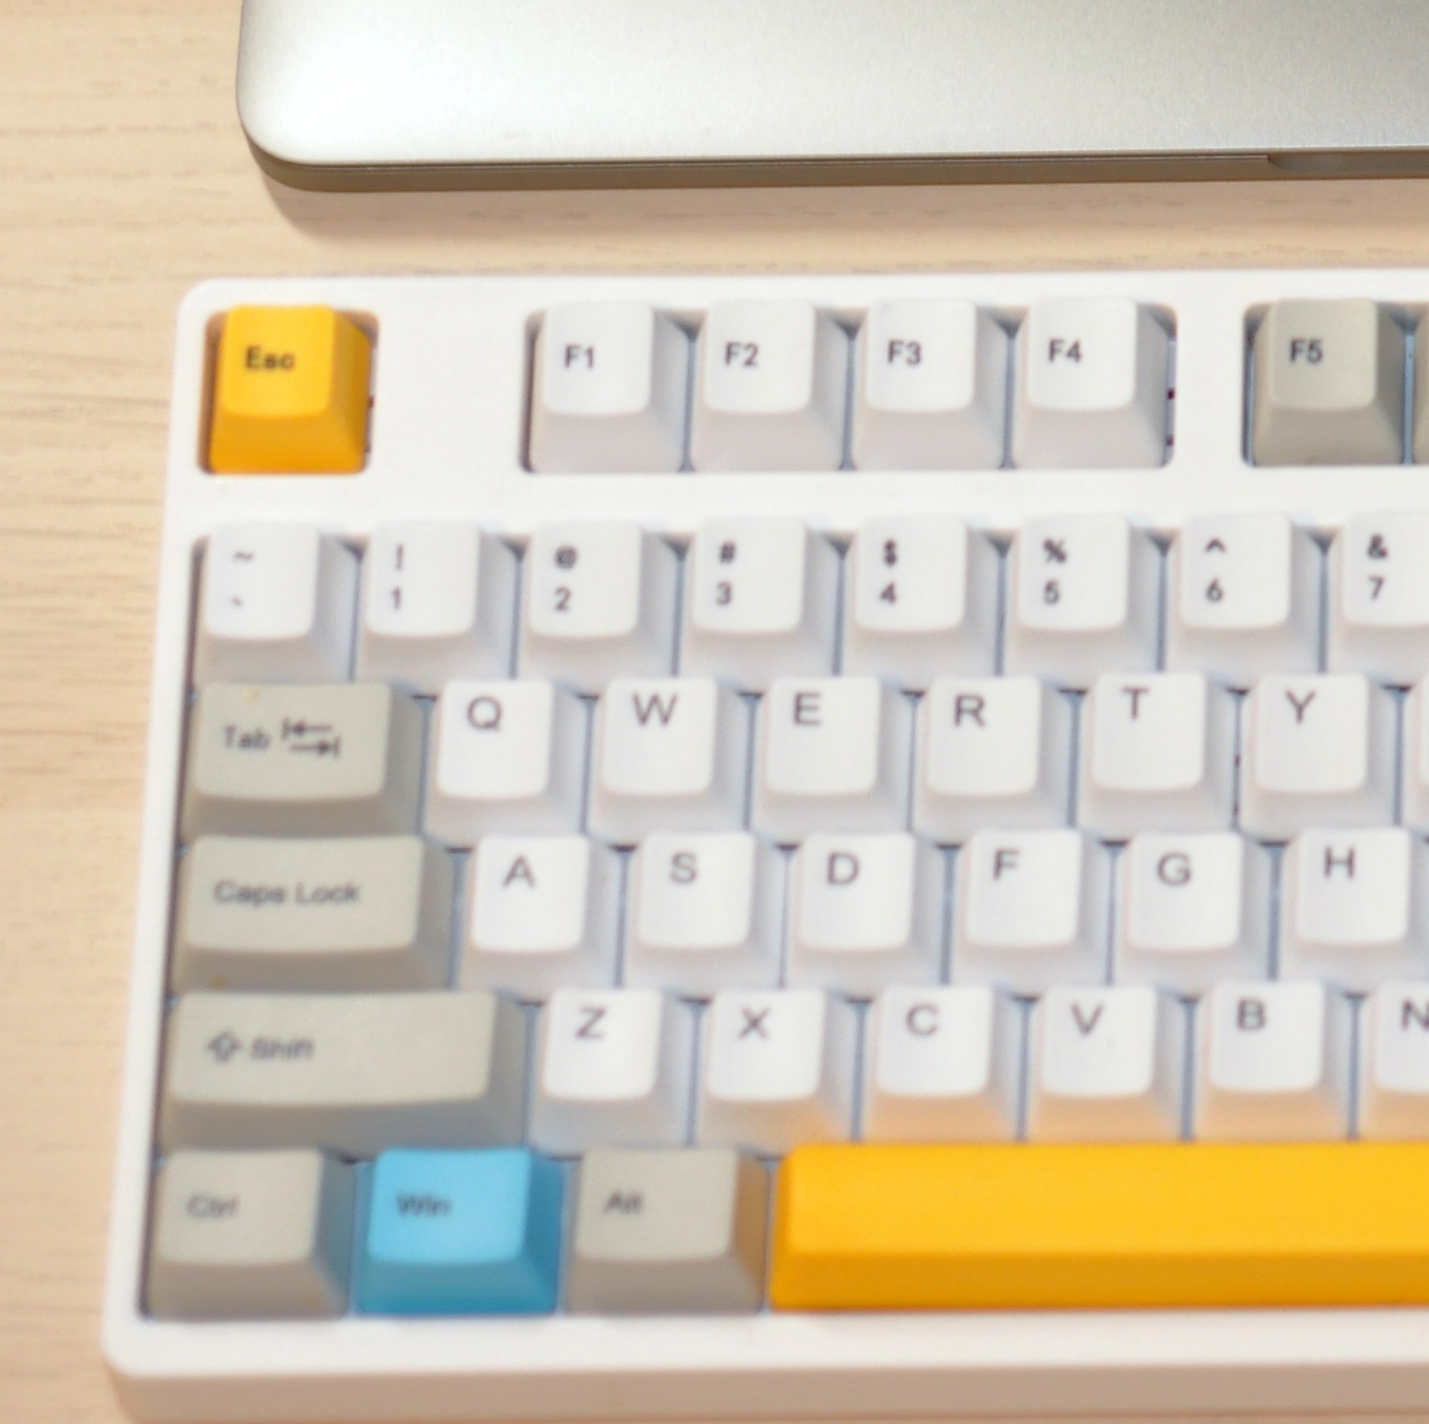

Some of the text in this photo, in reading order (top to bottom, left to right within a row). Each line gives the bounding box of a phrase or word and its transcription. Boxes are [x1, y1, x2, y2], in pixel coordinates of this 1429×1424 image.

[244, 345, 295, 371] Esc
[563, 343, 595, 369] F1
[723, 340, 759, 368] F2
[886, 339, 922, 366] F3
[1047, 338, 1082, 363] F4
[1288, 337, 1324, 365] F5
[718, 541, 737, 564] #
[1042, 538, 1068, 564] %
[1366, 534, 1388, 560] &
[554, 586, 572, 613] 2
[715, 580, 733, 607] 3
[879, 582, 897, 604] 4
[1043, 579, 1061, 606] 5
[1204, 578, 1224, 603] 6
[1368, 574, 1385, 600] 7
[465, 695, 503, 732] Q
[631, 693, 678, 727] W
[792, 691, 819, 726] E
[953, 693, 986, 727] R
[1121, 685, 1149, 720] T
[1285, 690, 1316, 724] Y
[224, 724, 271, 751] Tab
[502, 854, 535, 888] A
[668, 851, 698, 885] S
[825, 851, 860, 886] D
[992, 848, 1018, 881] F
[1155, 851, 1193, 887] G
[1323, 846, 1356, 879] H
[212, 880, 360, 908] Caps Lock
[574, 1006, 607, 1040] Z
[739, 1008, 768, 1039] X
[904, 1003, 938, 1037] C
[1069, 1003, 1104, 1037] V
[1235, 998, 1267, 1031] B
[248, 1036, 315, 1061] Shift
[184, 1193, 238, 1220] Ctrl
[395, 1193, 450, 1217] Win
[603, 1191, 643, 1215] Alt
